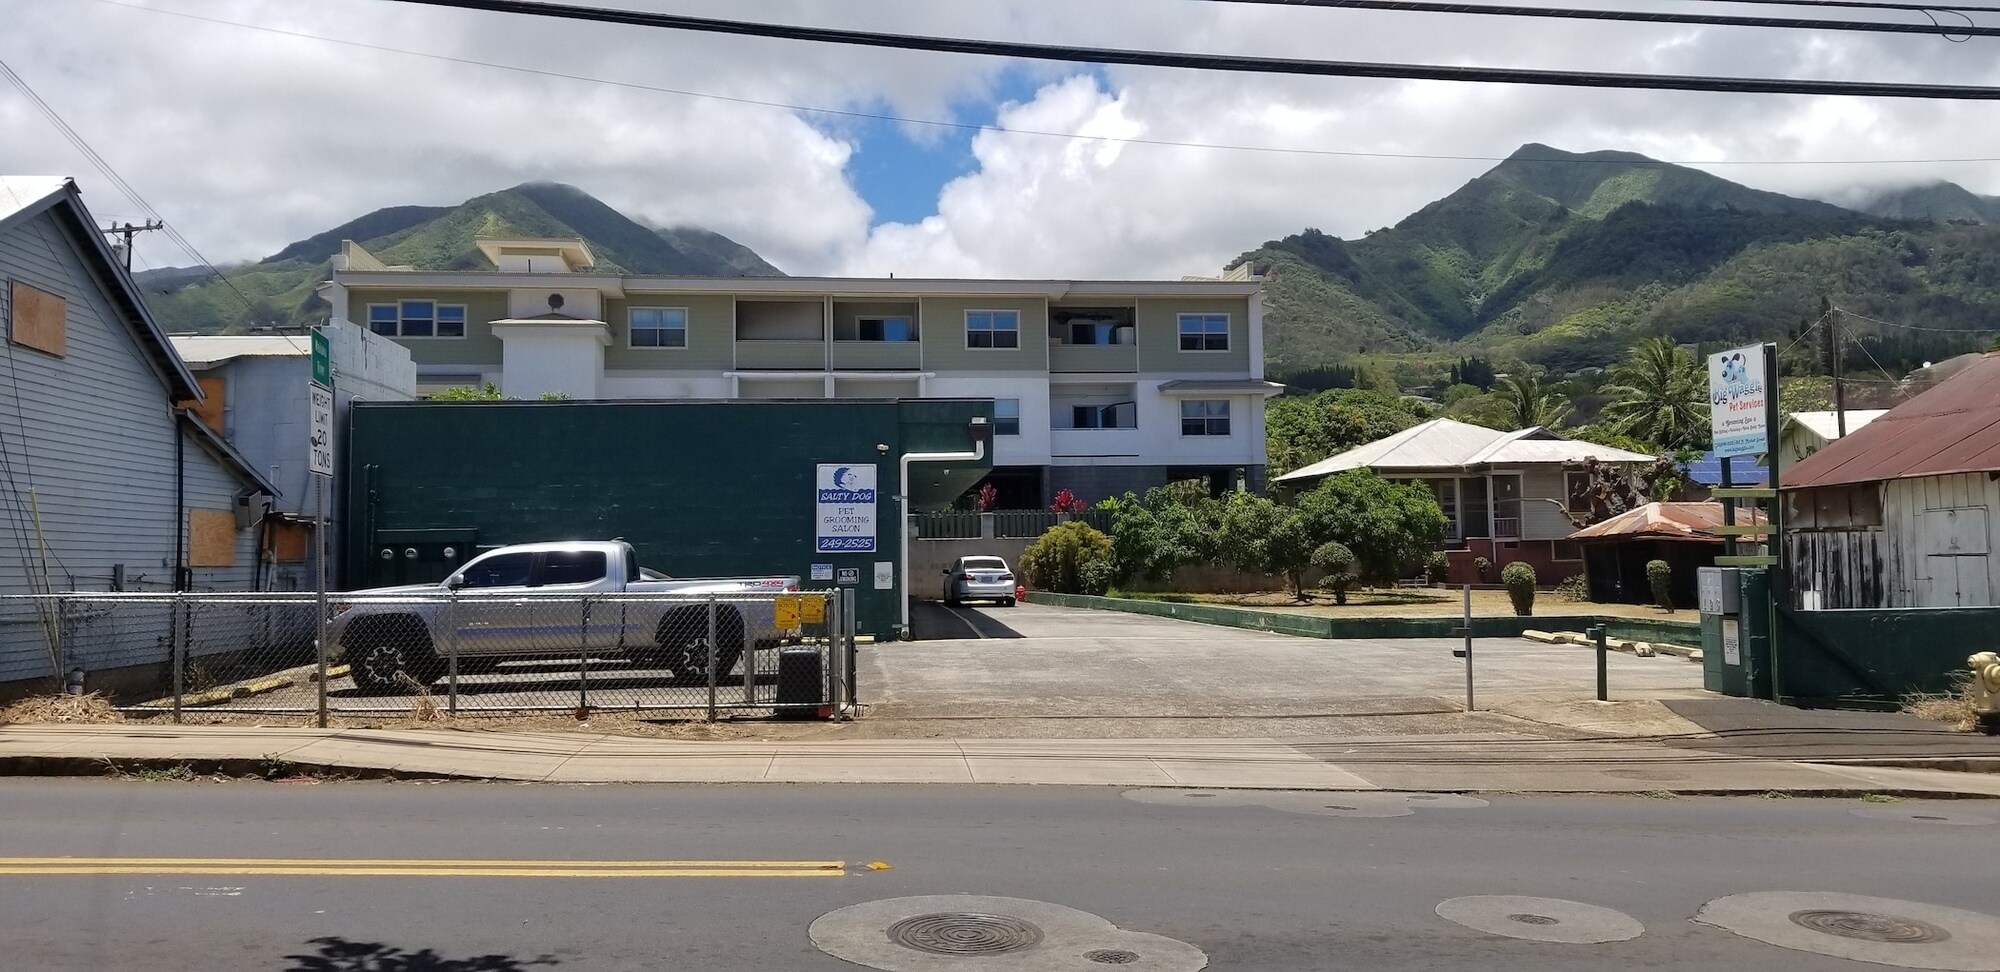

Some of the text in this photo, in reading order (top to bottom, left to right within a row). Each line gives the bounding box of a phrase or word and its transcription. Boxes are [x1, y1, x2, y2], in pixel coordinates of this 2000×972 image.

[1713, 381, 1763, 405] Big Waggle
[312, 392, 331, 410] WEIGHT
[1729, 400, 1764, 411] Pet Services
[314, 410, 328, 426] LIMIT
[317, 429, 327, 446] 20
[313, 449, 331, 469] TONS
[821, 492, 872, 501] SALTY DOG
[838, 507, 855, 515] PET
[823, 516, 870, 524] GROOMING
[832, 525, 861, 533] SALON
[820, 538, 873, 548] 249-2525
